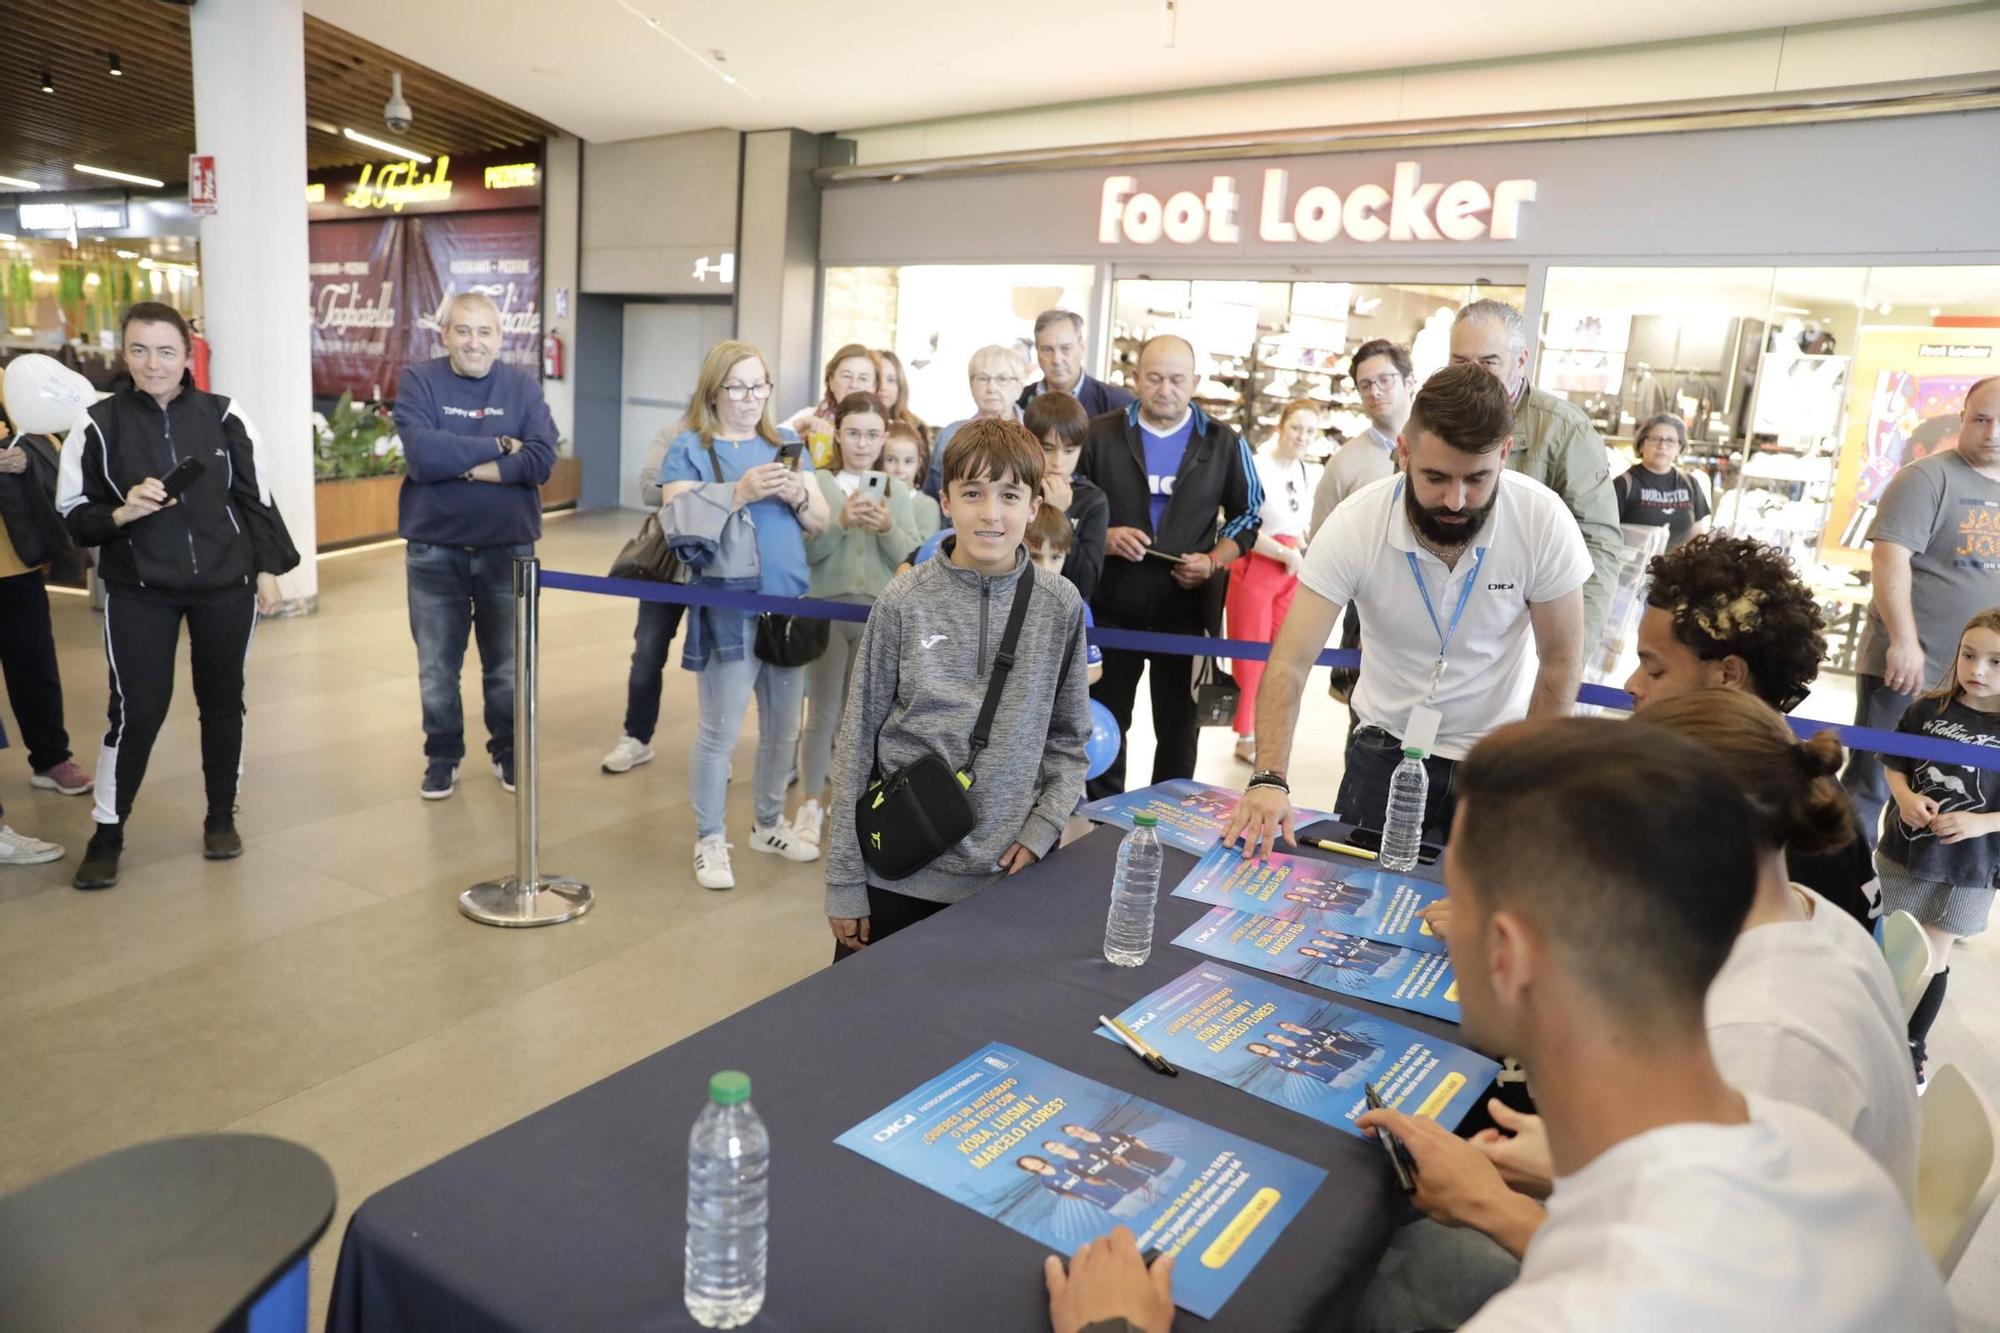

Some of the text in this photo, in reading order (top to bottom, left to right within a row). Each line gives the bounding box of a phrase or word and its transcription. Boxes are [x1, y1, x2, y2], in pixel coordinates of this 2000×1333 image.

[1099, 161, 1537, 244] Foot Locker
[1641, 488, 1689, 503] HOLLISTER
[1488, 583, 1514, 591] DIGI
[959, 1107, 974, 1117] UN
[972, 1078, 1017, 1110] AUTÓGRAFO
[976, 1104, 999, 1121] FOTO
[996, 1093, 1016, 1106] CON
[874, 1115, 916, 1142] DIGI
[958, 1095, 1039, 1154] KOBA, LUISMI Y
[970, 1098, 1067, 1168] MARCELO FLORES?
